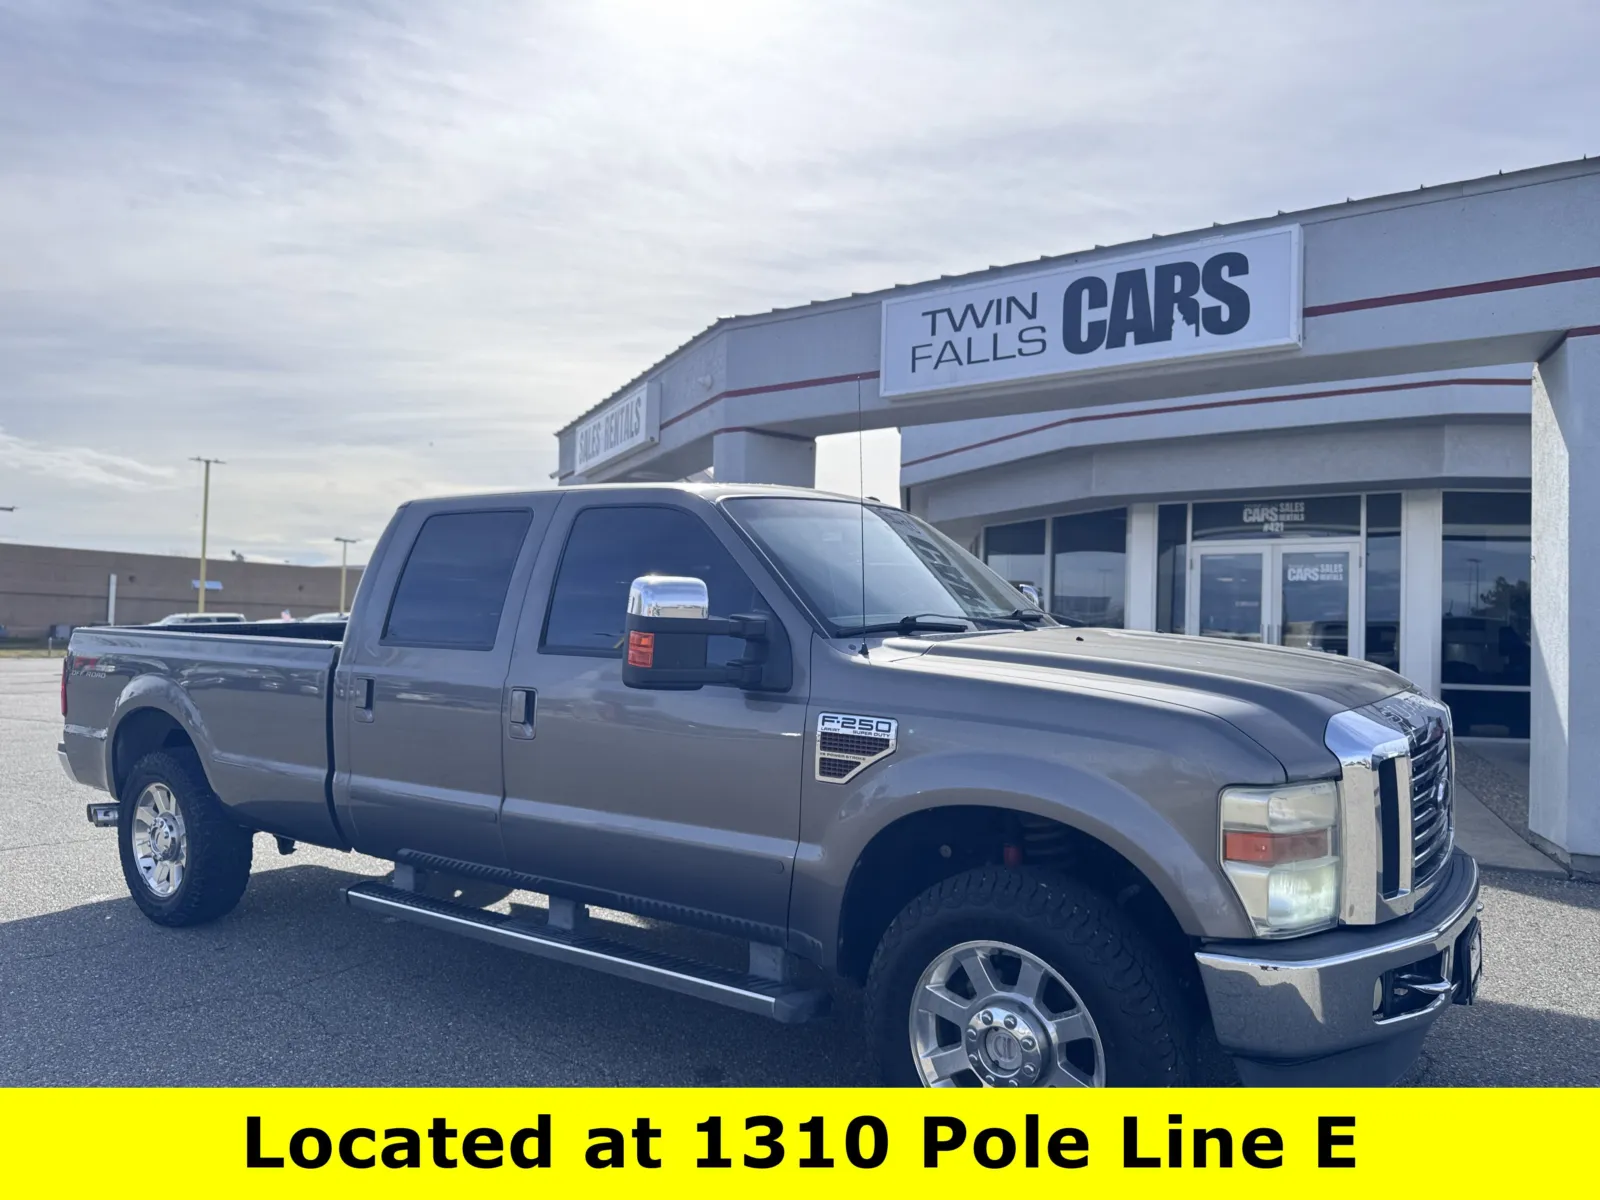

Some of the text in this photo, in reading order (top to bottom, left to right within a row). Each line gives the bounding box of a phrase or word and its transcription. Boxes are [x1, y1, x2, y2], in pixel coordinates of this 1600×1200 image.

[1062, 251, 1251, 355] CARS
[921, 292, 1038, 336] TWIN
[911, 325, 1047, 373] FALLS
[579, 396, 642, 465] SALES RENTALS
[1242, 507, 1279, 523] CARS
[1279, 502, 1305, 512] SALES
[1262, 522, 1285, 532] #421
[1287, 567, 1319, 581] CARS
[821, 715, 892, 733] F-250
